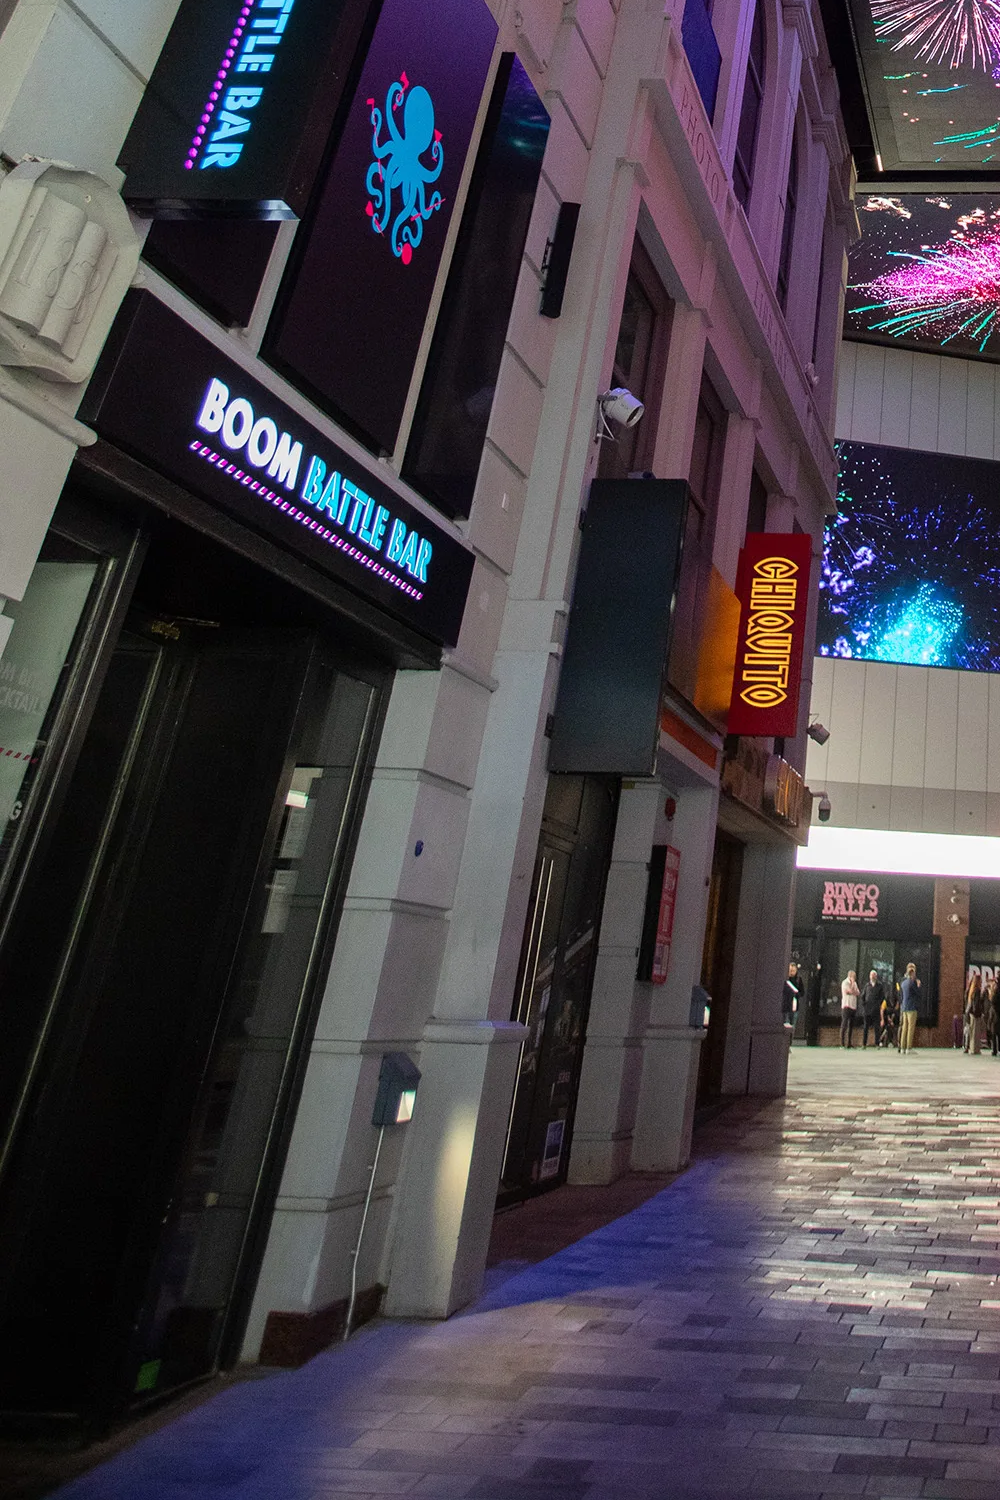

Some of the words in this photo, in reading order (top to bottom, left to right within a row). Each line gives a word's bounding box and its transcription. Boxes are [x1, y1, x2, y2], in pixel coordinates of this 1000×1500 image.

[200, 87, 264, 170] BAR
[197, 378, 304, 490] BOOM
[300, 455, 390, 551] BATTLE
[387, 518, 433, 584] BAR
[740, 556, 799, 708] CHIQUITO
[822, 898, 879, 918] BALLS
[823, 880, 881, 901] BINGO
